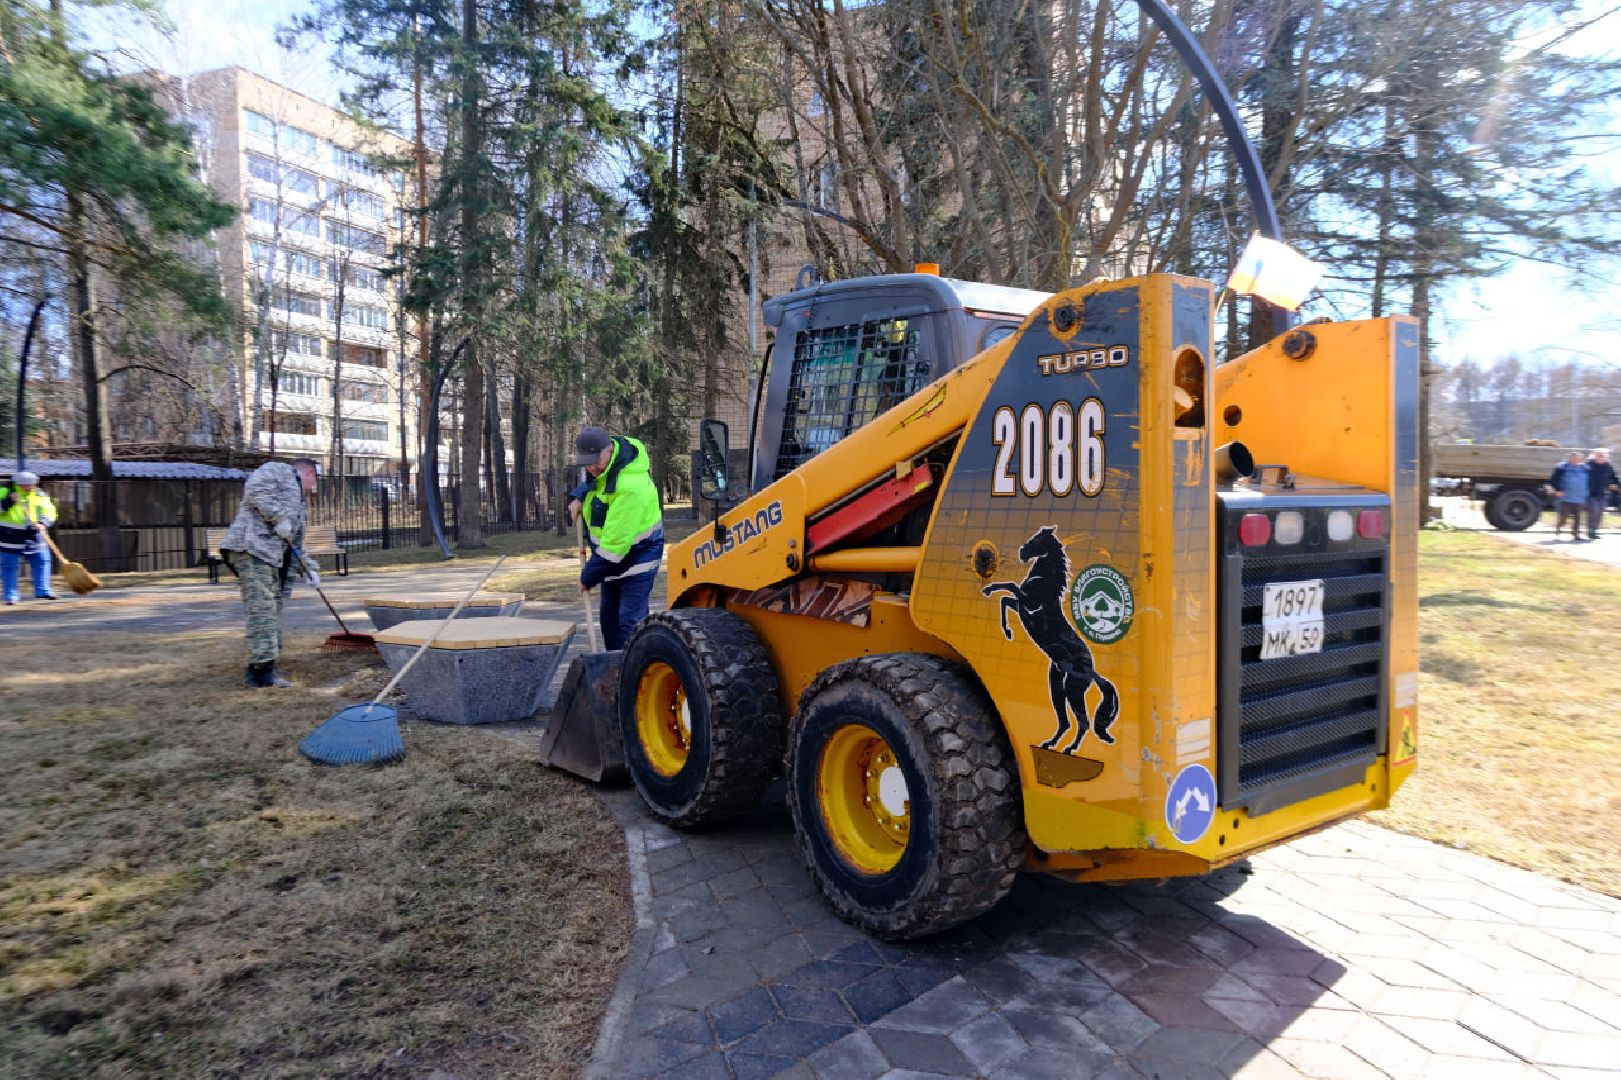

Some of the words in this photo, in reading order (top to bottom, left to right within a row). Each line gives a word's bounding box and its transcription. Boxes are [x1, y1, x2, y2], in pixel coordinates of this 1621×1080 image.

[1038, 345, 1129, 376] TURBO
[992, 396, 1106, 497] 2086
[694, 499, 782, 571] MUSTANG
[1274, 587, 1316, 617] 1897
